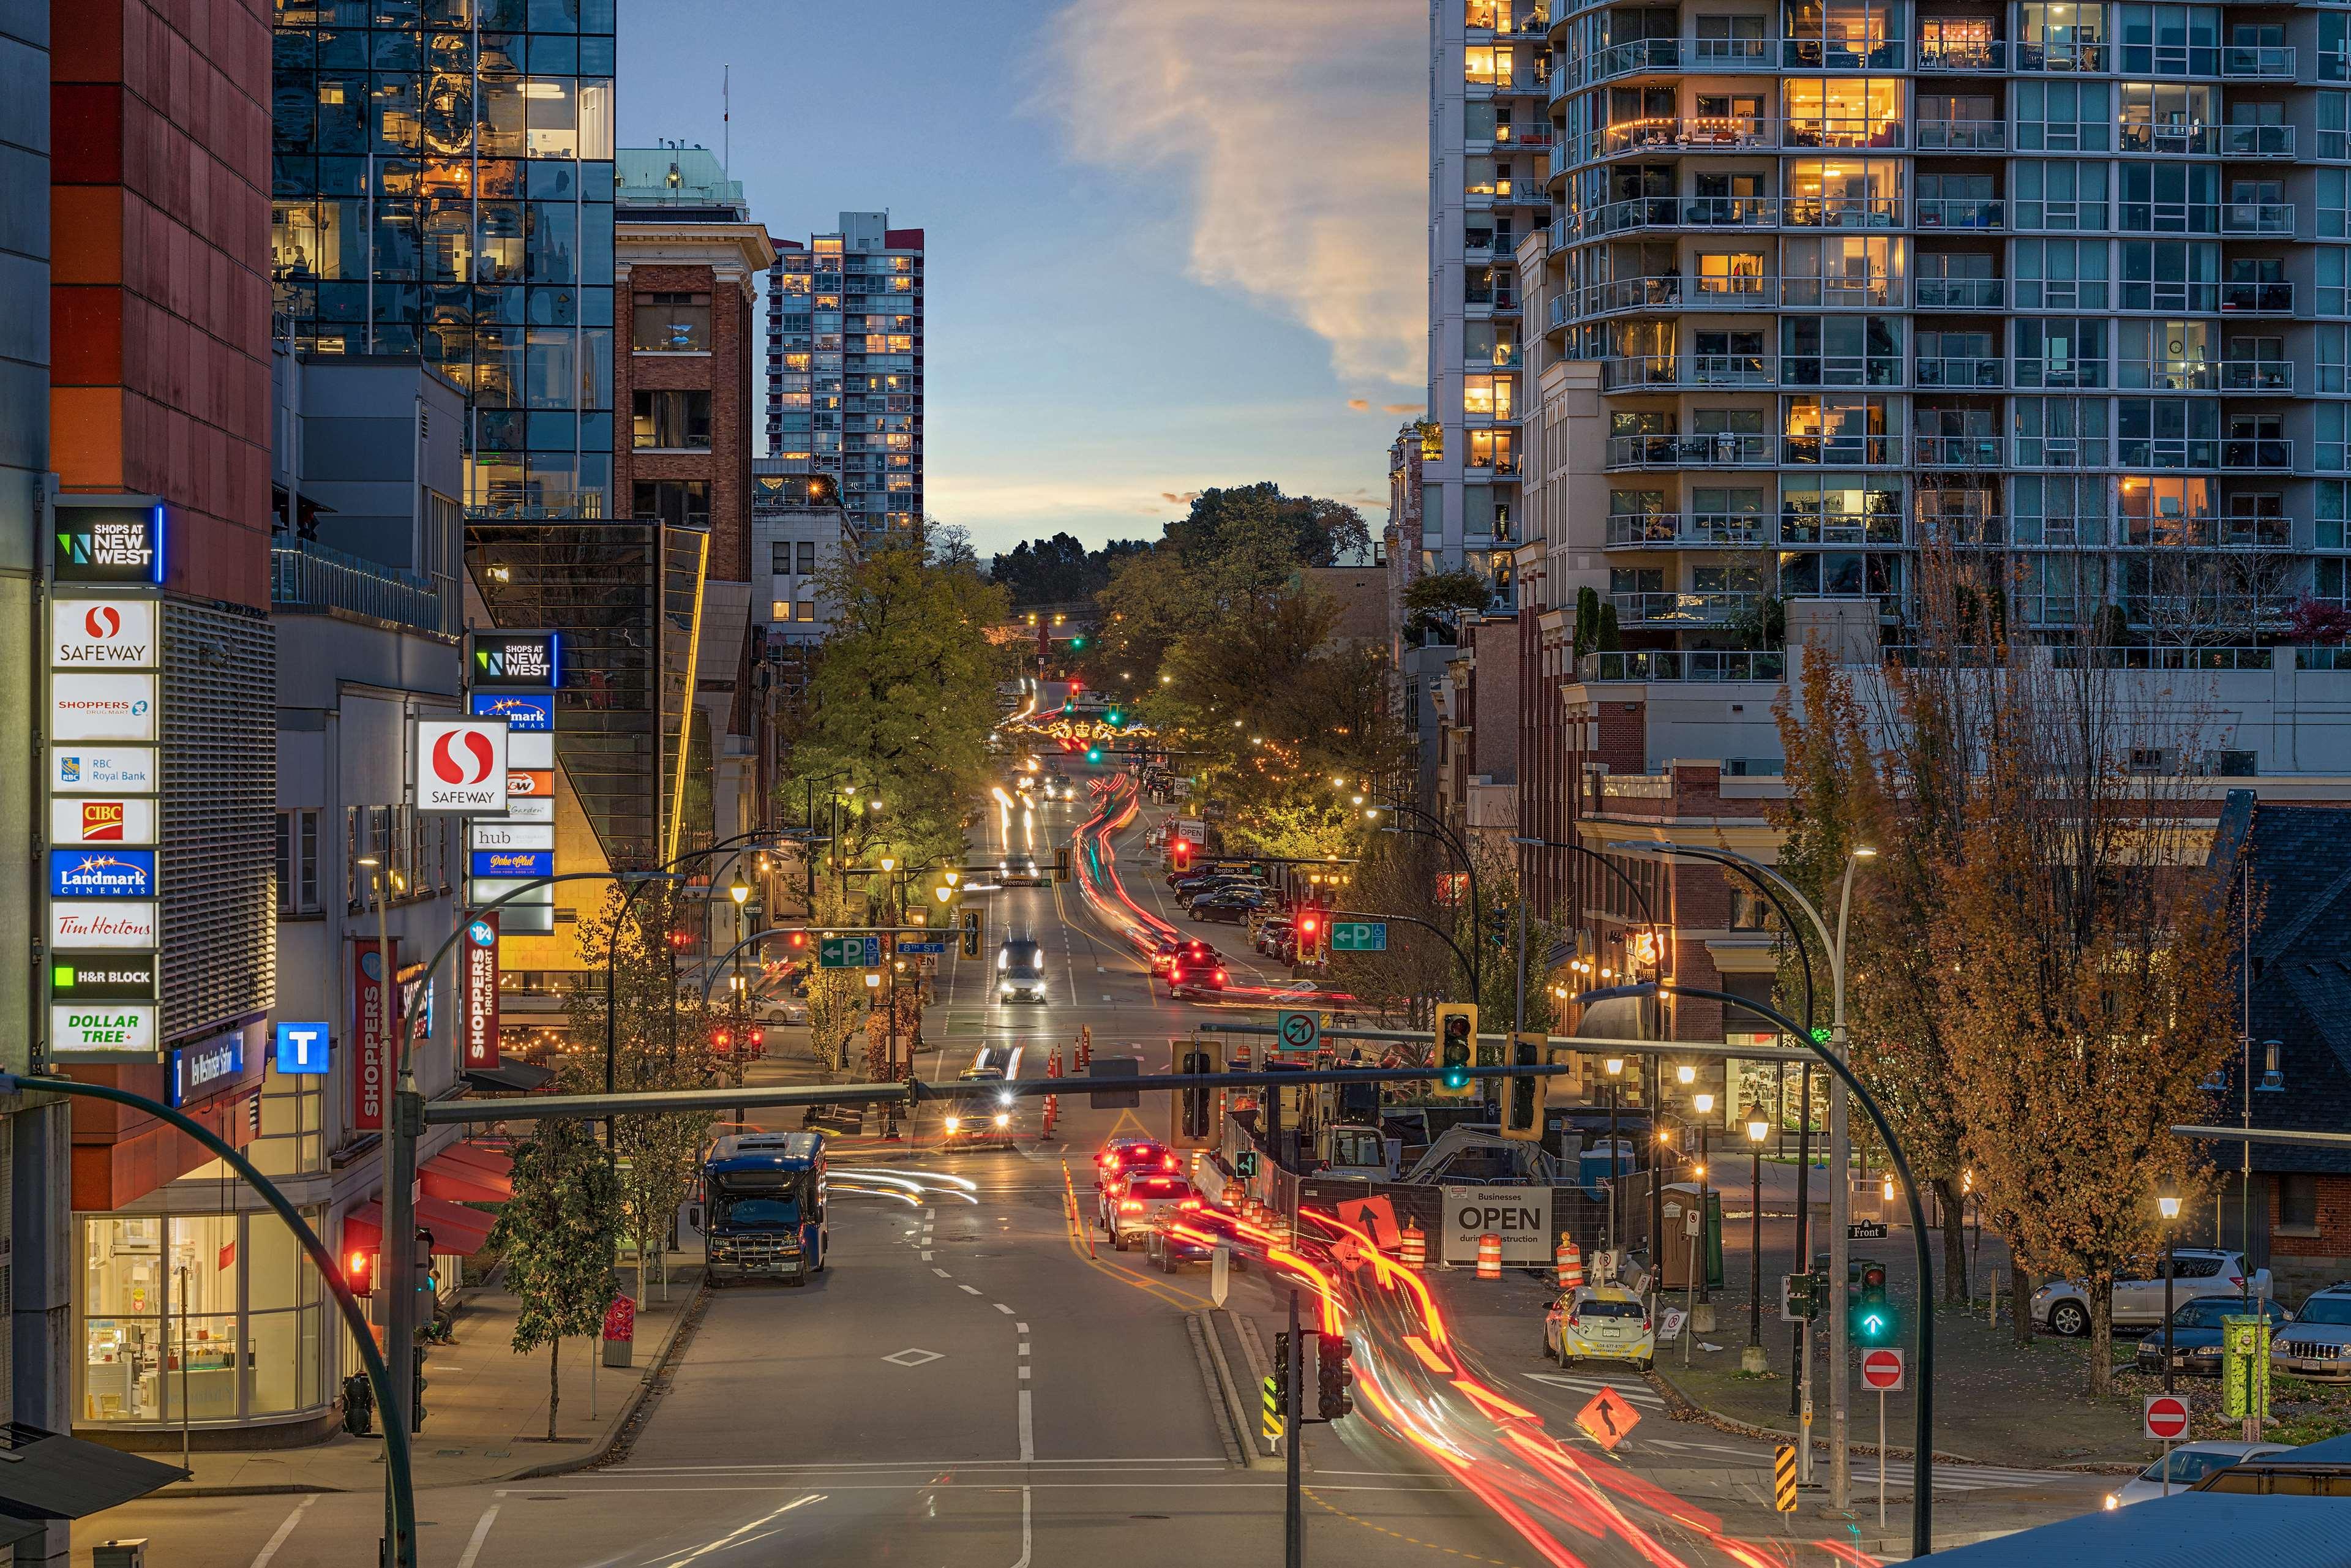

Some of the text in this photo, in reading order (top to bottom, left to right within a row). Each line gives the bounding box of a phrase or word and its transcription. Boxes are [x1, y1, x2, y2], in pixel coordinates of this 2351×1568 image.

[95, 524, 144, 534] SHOPS AT
[95, 535, 143, 549] NEW
[95, 550, 152, 565] WEST
[61, 645, 146, 661] SAFEWAY
[506, 653, 543, 664] NEW
[506, 664, 550, 676] WEST
[93, 759, 112, 768] RBC
[93, 771, 145, 782] Royal Bank
[508, 782, 531, 791] &W
[432, 792, 495, 803] SAFEWAY
[84, 806, 121, 820] CIBC
[479, 831, 511, 844] hub
[490, 855, 536, 868] Poke Club
[61, 871, 145, 885] Landmark
[59, 915, 151, 936] Tim Hortons
[1354, 925, 1370, 947] P
[843, 940, 862, 965] P
[78, 972, 150, 983] H&R BLOCK
[472, 949, 484, 1059] SHOPPERS
[69, 1015, 138, 1028] DOLLAR
[81, 1030, 125, 1043] TREE
[289, 1031, 317, 1065] T
[365, 986, 378, 1117] SHOPPERS
[200, 1049, 220, 1083] Westminster
[220, 1044, 232, 1076] Station
[1458, 1207, 1540, 1230] OPEN
[1854, 1227, 1879, 1237] Front
